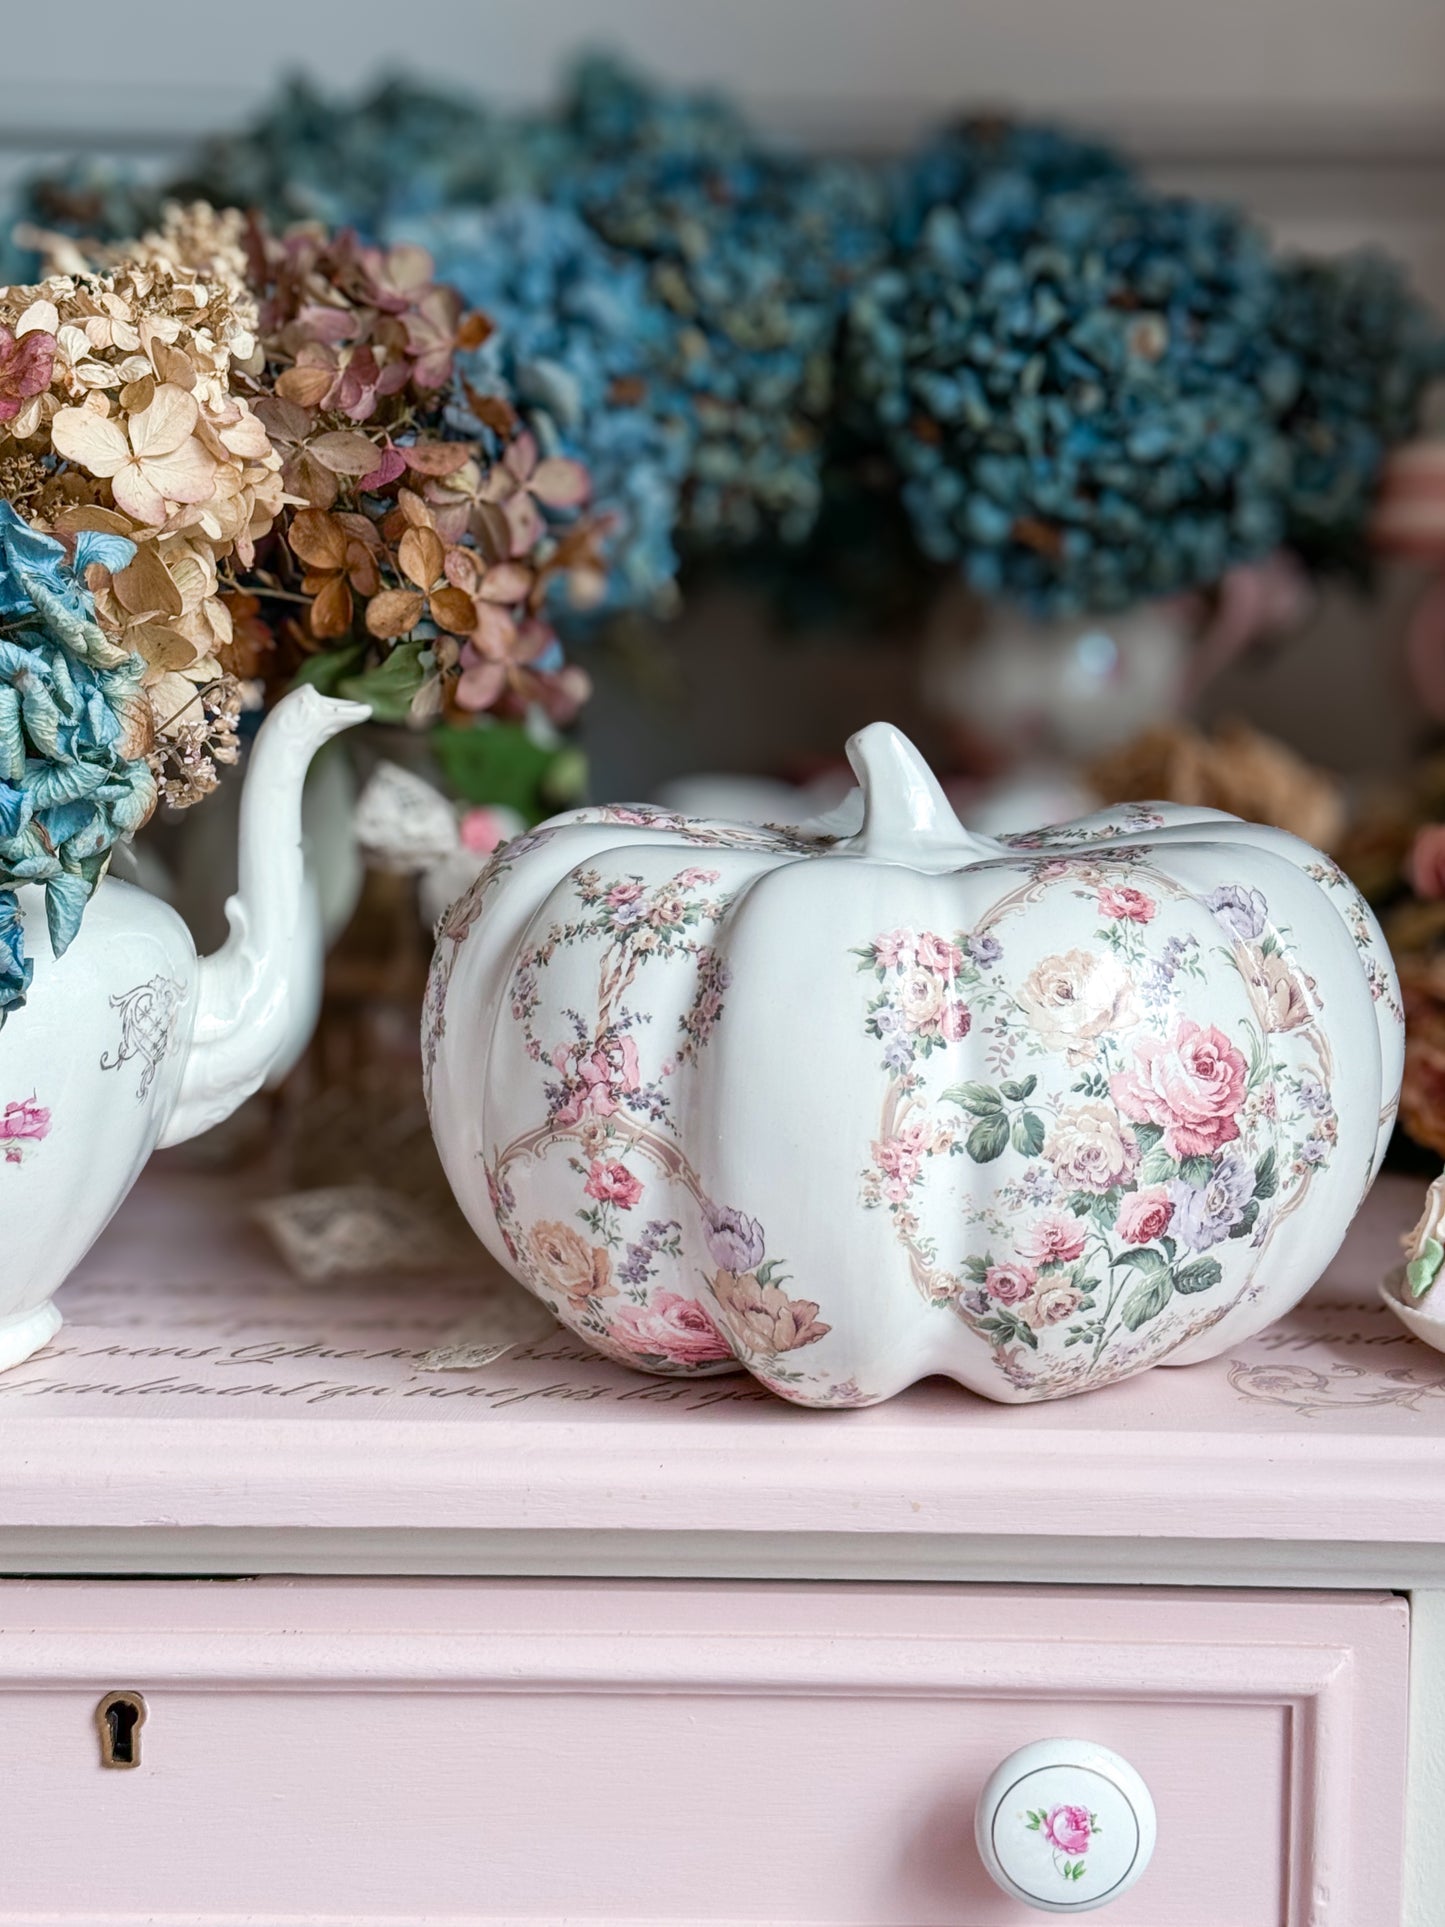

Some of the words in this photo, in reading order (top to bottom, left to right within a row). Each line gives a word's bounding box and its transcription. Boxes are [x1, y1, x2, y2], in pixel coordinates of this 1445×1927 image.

[78, 1345, 222, 1360] nous
[22, 1375, 331, 1397] seulement
[490, 1382, 613, 1409] fois
[616, 1381, 692, 1402] les
